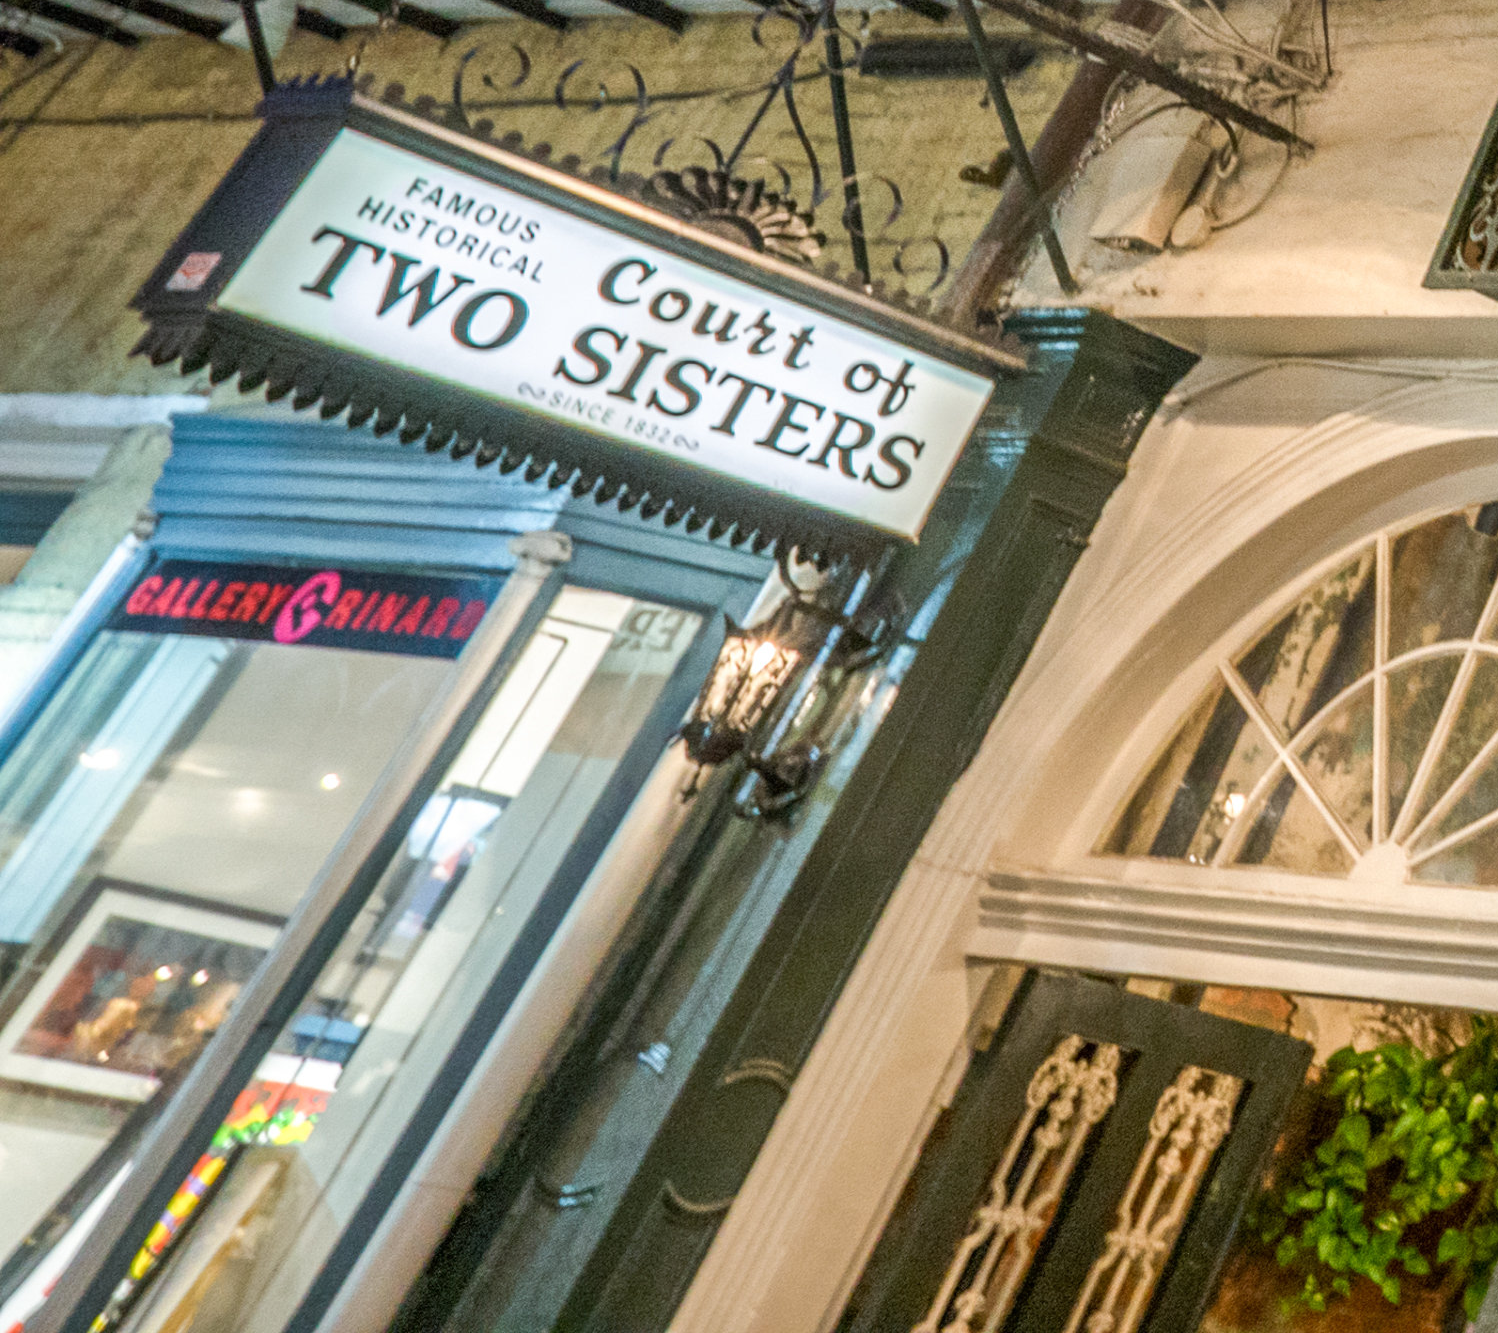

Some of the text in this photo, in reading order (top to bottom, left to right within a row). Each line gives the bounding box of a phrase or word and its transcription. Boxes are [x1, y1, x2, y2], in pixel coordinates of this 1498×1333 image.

[356, 196, 544, 284] HISTORICAL
[405, 177, 541, 244] FAMOUS
[299, 223, 926, 491] TWO SISTERS
[597, 255, 916, 418] Court of
[548, 392, 617, 425] SINCE
[126, 574, 294, 625] GALLERY
